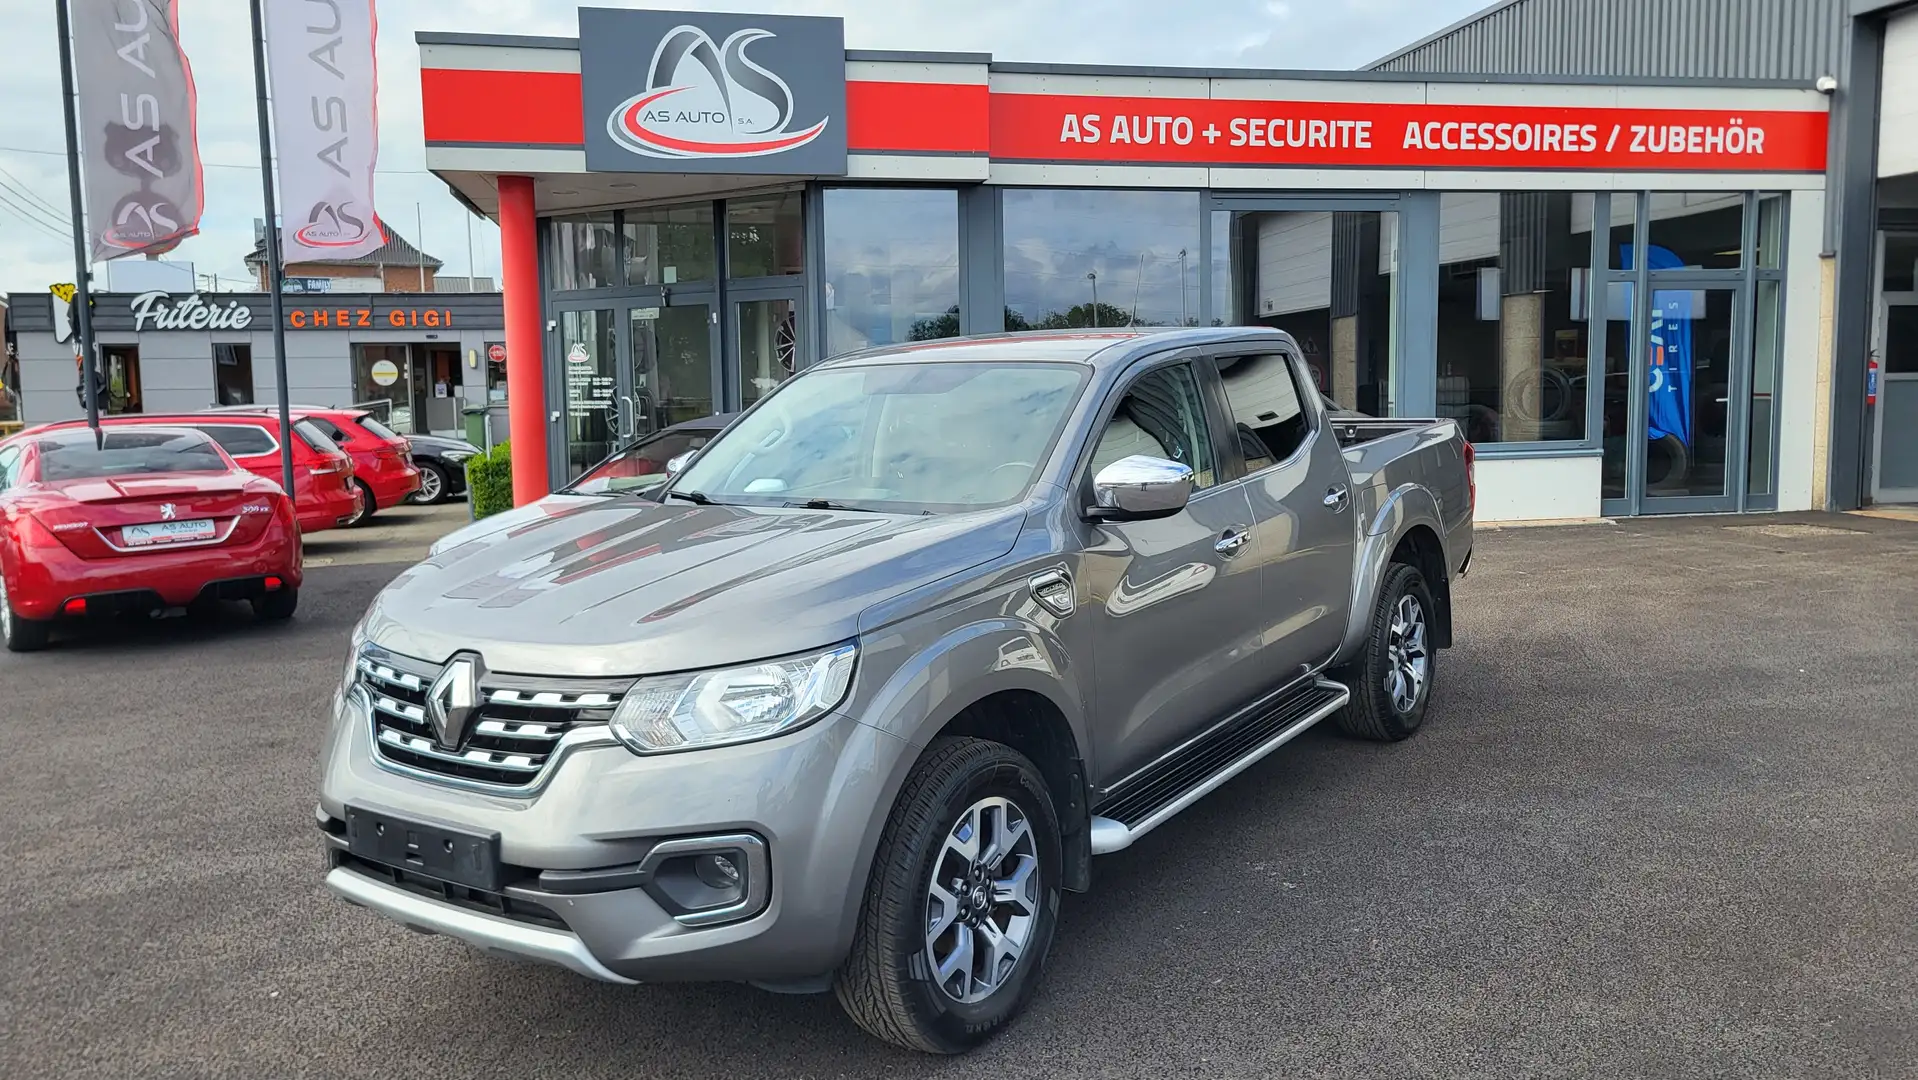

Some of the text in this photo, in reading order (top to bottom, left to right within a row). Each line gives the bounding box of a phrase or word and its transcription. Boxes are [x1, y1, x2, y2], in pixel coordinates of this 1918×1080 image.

[121, 93, 164, 179] AS
[311, 96, 350, 178] AS
[643, 110, 670, 123] AS
[675, 111, 725, 124] AUTO
[1060, 114, 1765, 155] AS AUTO + SECURITE ACCESSOIRES / ZUBEHÖR
[130, 289, 252, 332] Friterie
[290, 309, 452, 327] CHEZ GIGI
[1668, 302, 1679, 393] TIRES
[179, 521, 207, 529] AUTO
